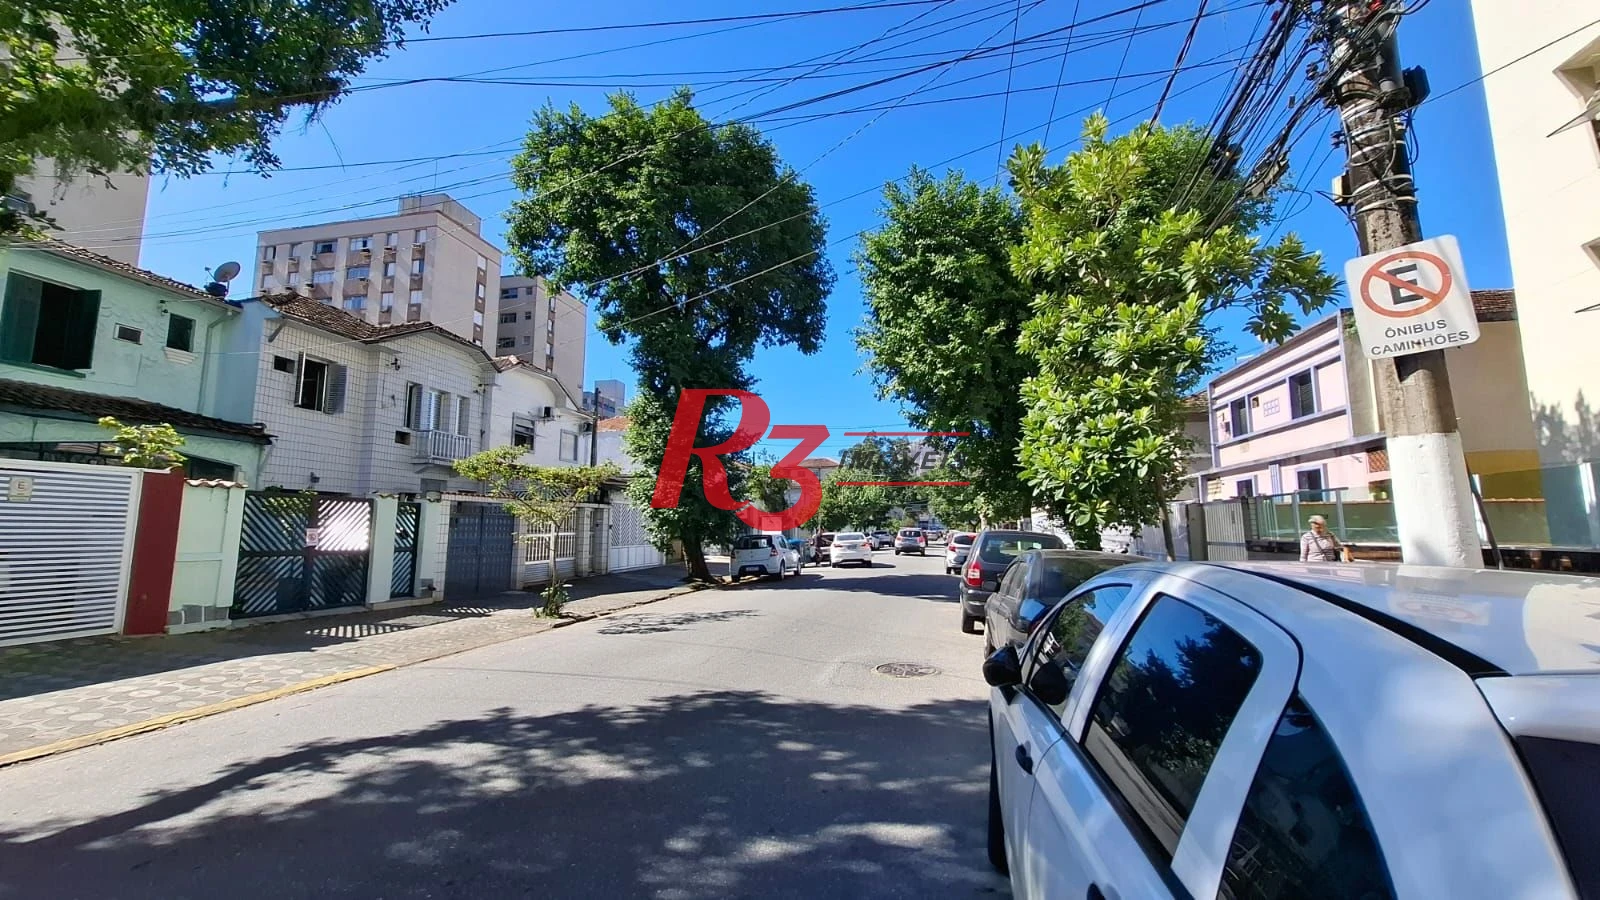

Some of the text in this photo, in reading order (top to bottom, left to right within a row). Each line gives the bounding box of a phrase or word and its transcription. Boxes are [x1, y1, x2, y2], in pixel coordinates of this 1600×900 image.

[1386, 263, 1424, 306] E
[1384, 319, 1448, 338] ÔNIBUS
[1371, 330, 1470, 355] CAMINHÕES
